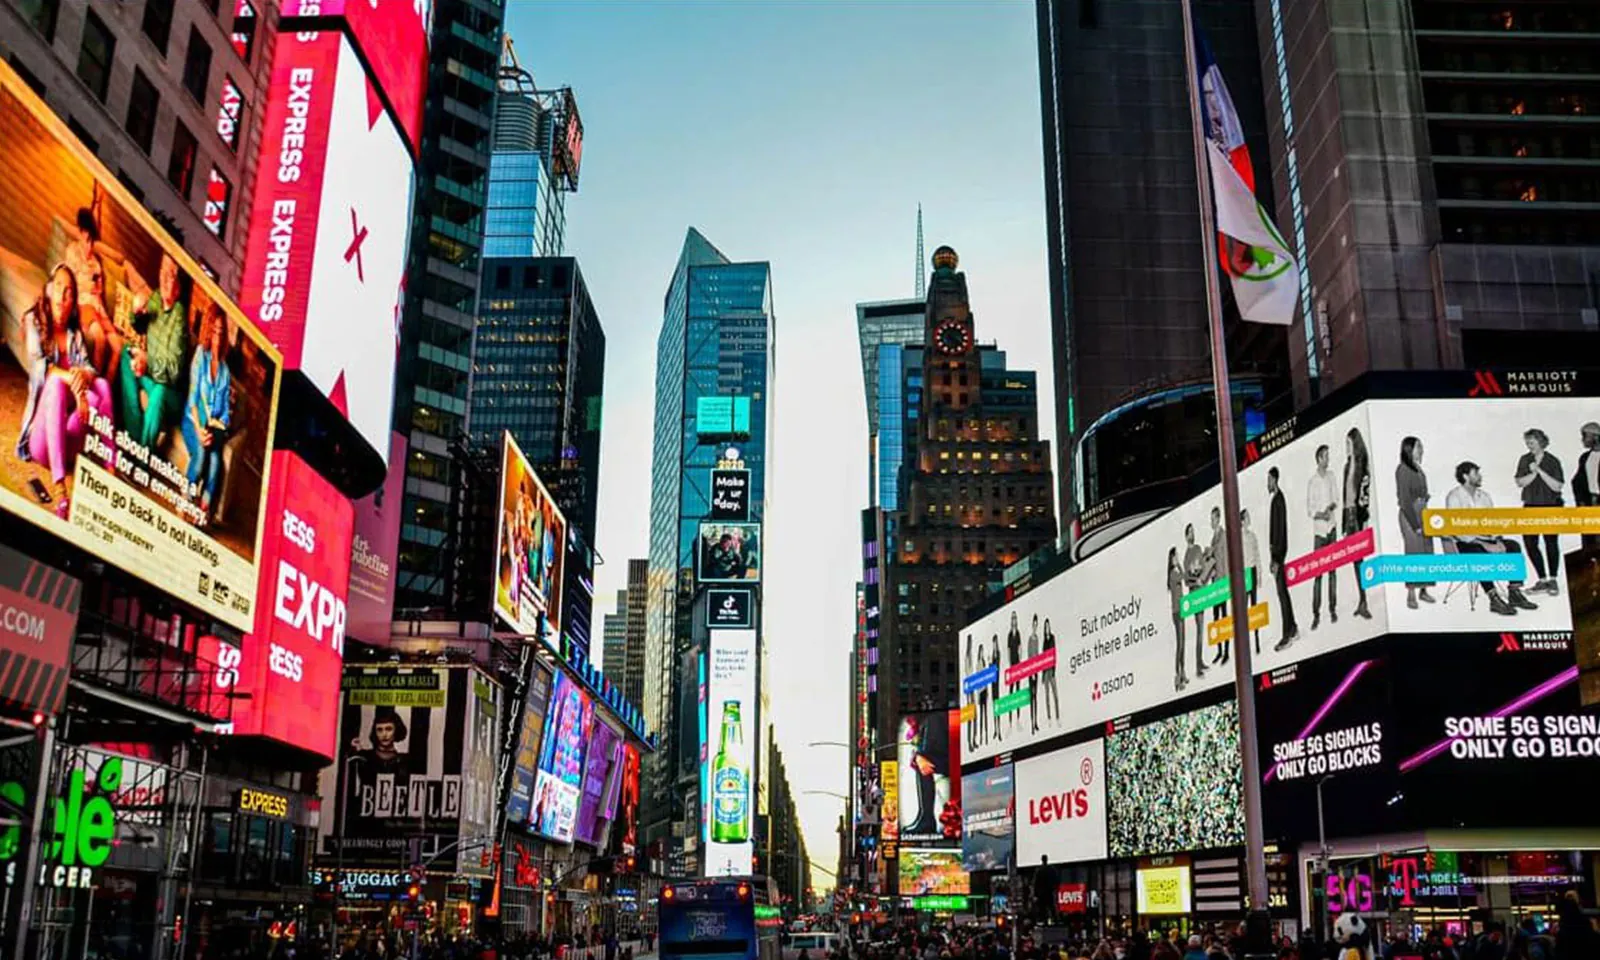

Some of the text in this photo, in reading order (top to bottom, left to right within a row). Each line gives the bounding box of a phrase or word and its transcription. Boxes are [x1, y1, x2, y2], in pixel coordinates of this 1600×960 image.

[279, 67, 313, 183] EXPRESS
[260, 199, 296, 322] EXPRESS
[1507, 371, 1578, 381] MARRIOTT
[1508, 382, 1572, 393] MARQUIS
[1260, 416, 1298, 445] MARRIOTT
[1260, 429, 1295, 455] MARQUIS
[84, 433, 113, 464] plan
[115, 450, 134, 475] for
[133, 467, 150, 487] an
[88, 406, 114, 440] Talk
[115, 430, 150, 464] about
[149, 454, 190, 495] making
[716, 476, 745, 488] Make
[79, 466, 221, 569] Then go back to not talking.
[1451, 517, 1479, 527] Make
[1481, 516, 1515, 528] design
[1517, 515, 1570, 527] accessible
[1405, 564, 1426, 574] new
[1429, 562, 1469, 575] product
[1471, 563, 1496, 575] spec
[1081, 594, 1142, 638] But nobody
[1069, 648, 1092, 675] gets
[1093, 632, 1122, 660] there
[1122, 621, 1159, 648] alone.
[1522, 632, 1573, 642] MARRIOTT
[1523, 641, 1569, 650] MARQUIS
[1101, 671, 1134, 695] asana
[1444, 716, 1600, 737] SOME 5G SIGN
[1273, 722, 1383, 763] SOME 5G SIGNALS
[1451, 738, 1510, 760] ONLY
[1512, 738, 1546, 758] GO
[1276, 744, 1382, 781] ONLY GO BLOCKS
[240, 788, 288, 818] EXPRESS
[360, 778, 461, 818] BEETLE
[1326, 874, 1373, 912] 5G
